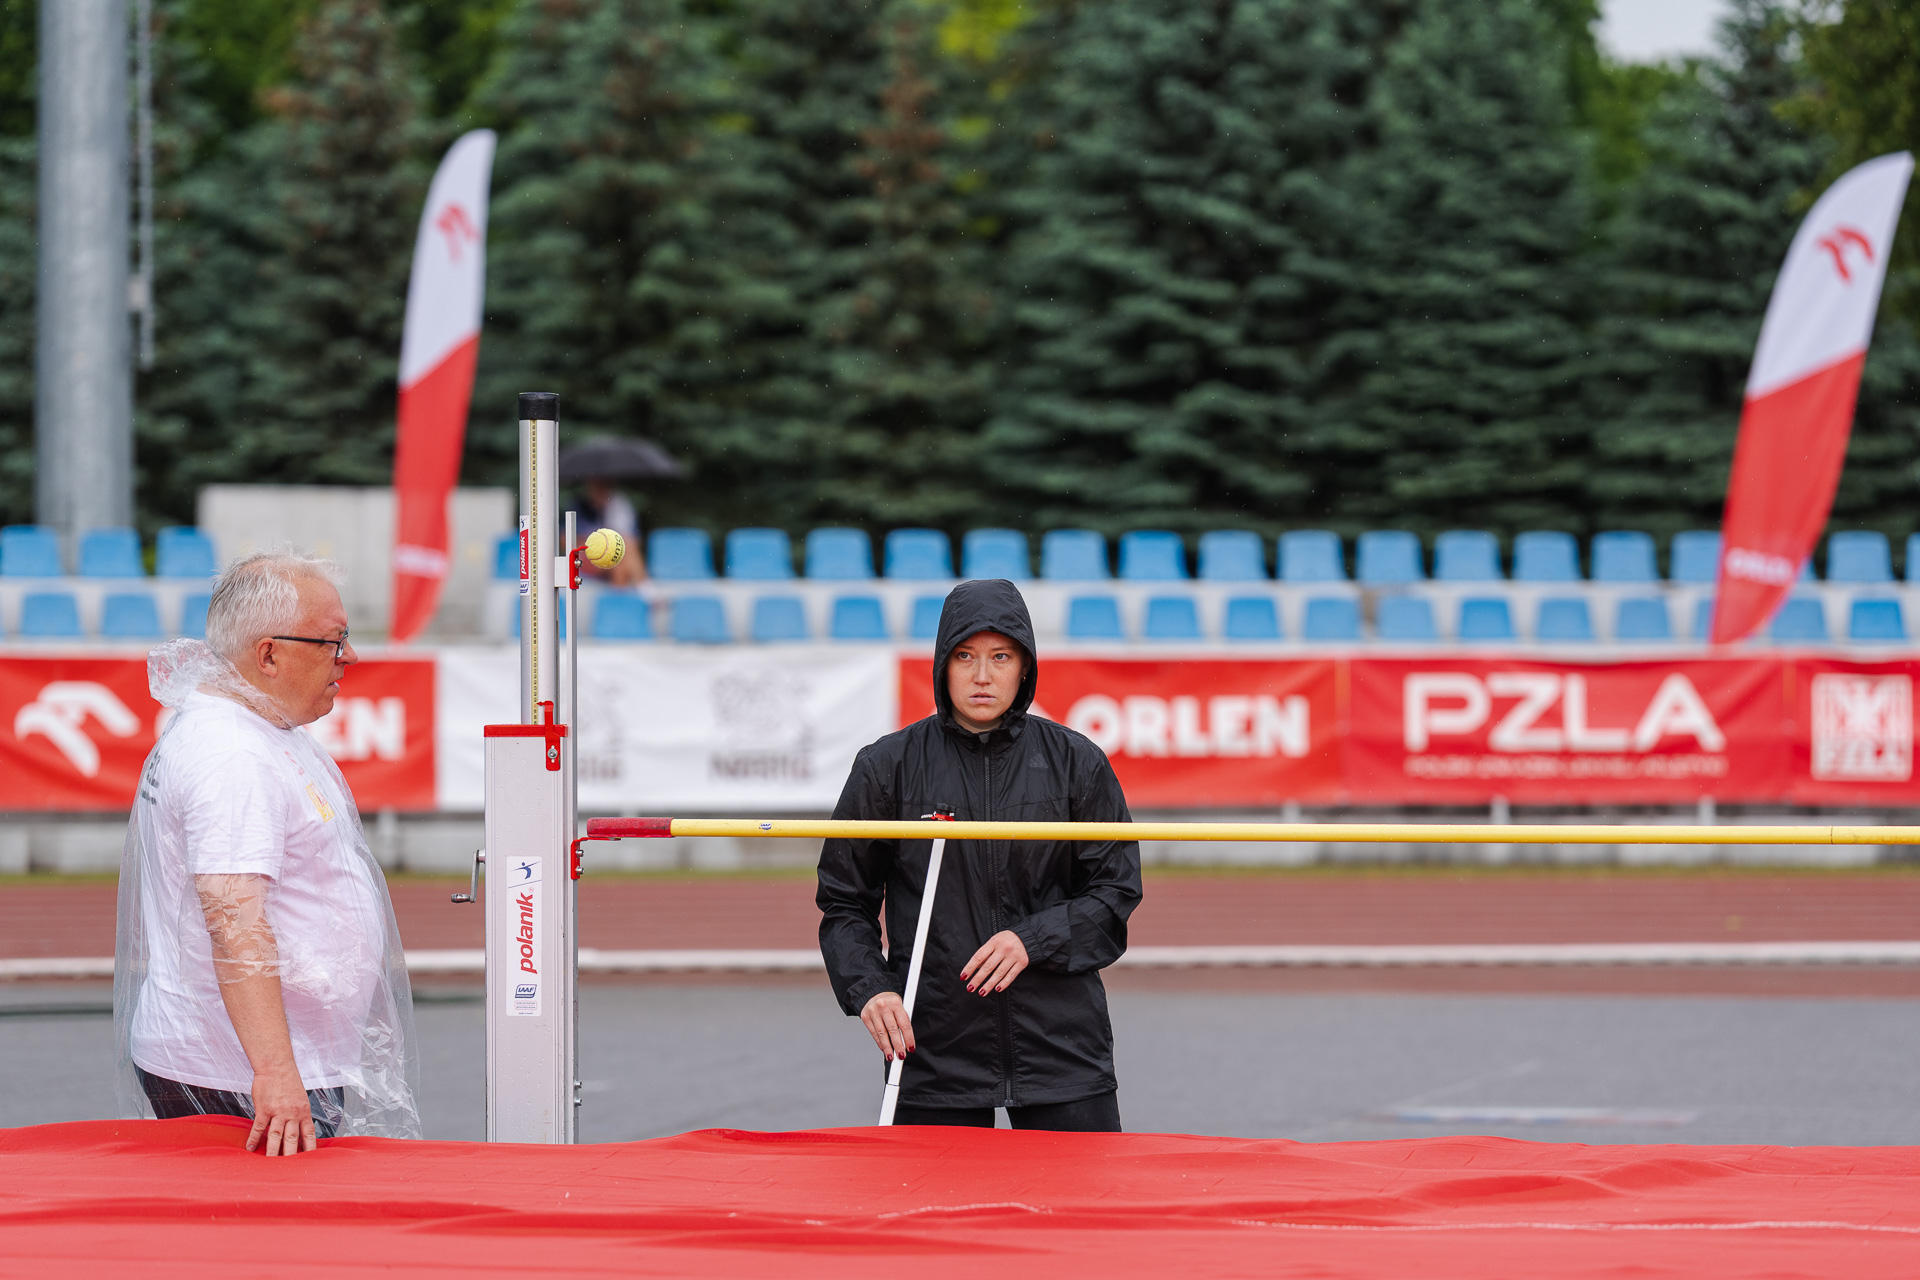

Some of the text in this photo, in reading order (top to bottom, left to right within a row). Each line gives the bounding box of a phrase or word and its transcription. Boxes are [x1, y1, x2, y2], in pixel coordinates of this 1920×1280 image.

[1065, 694, 1311, 759] ORLEN
[1403, 672, 1726, 753] PZLA
[516, 891, 538, 975] polanik
